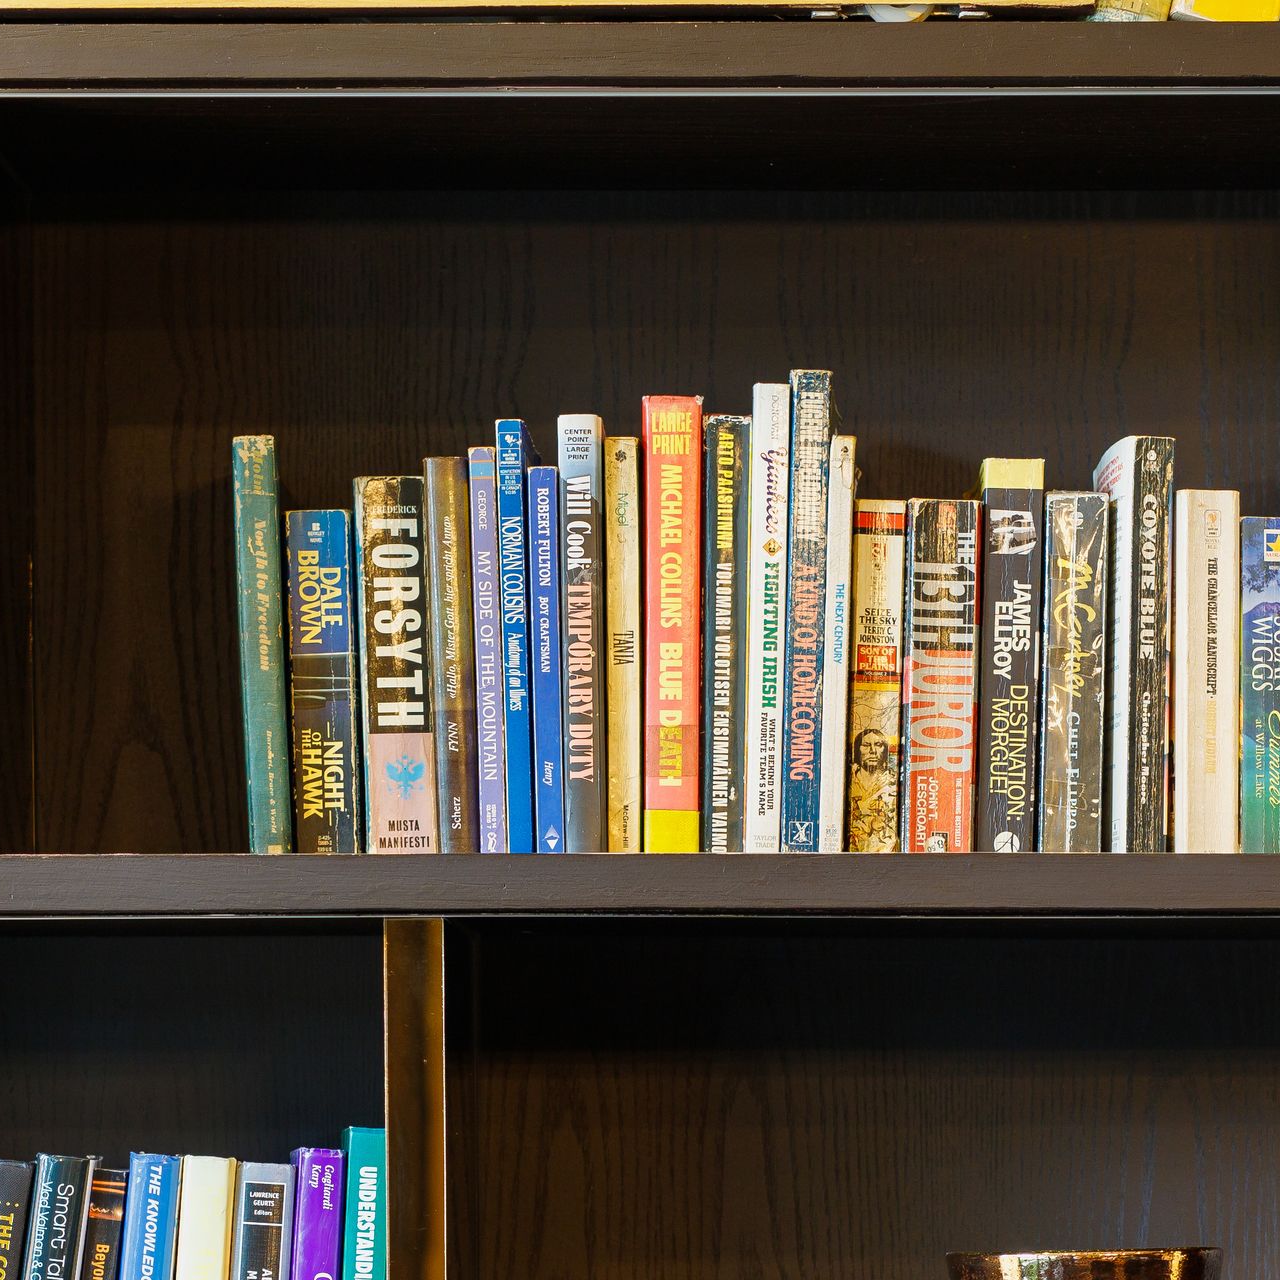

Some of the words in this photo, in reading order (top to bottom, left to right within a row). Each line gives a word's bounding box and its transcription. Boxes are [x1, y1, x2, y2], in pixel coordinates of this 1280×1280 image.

[566, 476, 591, 514] Will
[660, 464, 681, 548] MICHAEL
[477, 551, 492, 577] MY
[567, 521, 592, 570] Cook
[1142, 494, 1157, 590] COYOTE
[298, 550, 321, 645] BROWN
[320, 567, 343, 627] DALE
[371, 518, 424, 726] FORSYTH
[479, 581, 494, 619] SIDE
[661, 552, 681, 628] COLLINS
[762, 562, 779, 651] FIGHTING
[1012, 580, 1031, 652] JAMES
[480, 624, 494, 648] OF
[613, 631, 634, 666] TANIA
[994, 602, 1011, 680] ELLROY
[1139, 599, 1155, 659] BLUE
[1251, 616, 1273, 691] WIGGS
[481, 653, 495, 686] THE
[762, 656, 778, 709] IRISH
[482, 692, 497, 780] MOUNTAIN
[303, 749, 323, 819] HAWK
[323, 742, 344, 811] NIGHT
[916, 776, 926, 847] LESCROART
[148, 1165, 162, 1194] THE
